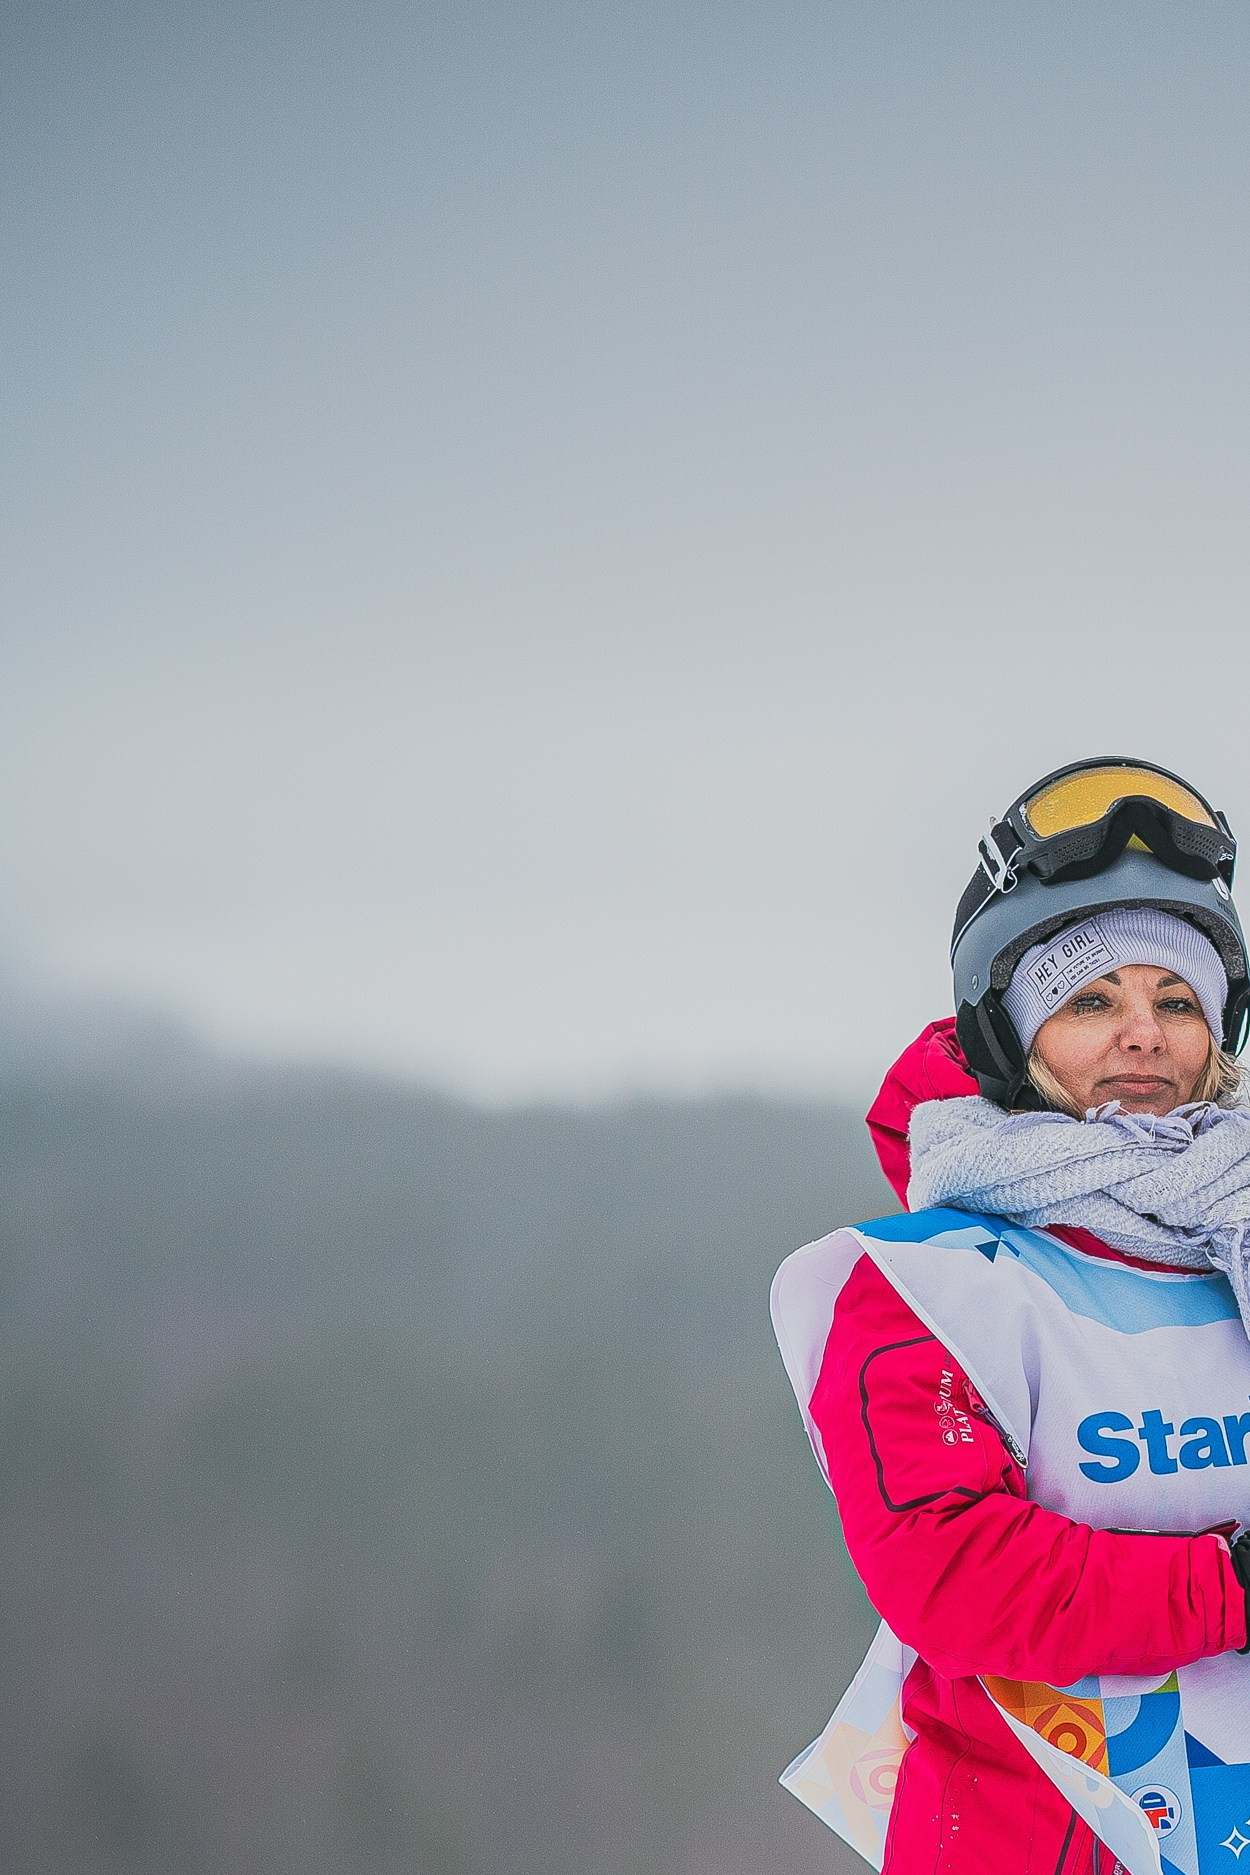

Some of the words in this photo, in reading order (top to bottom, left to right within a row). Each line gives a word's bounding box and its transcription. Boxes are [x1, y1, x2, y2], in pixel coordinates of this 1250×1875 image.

[1034, 954, 1058, 985] HEY
[1062, 931, 1094, 958] GIRL
[1076, 968, 1084, 976] CAN
